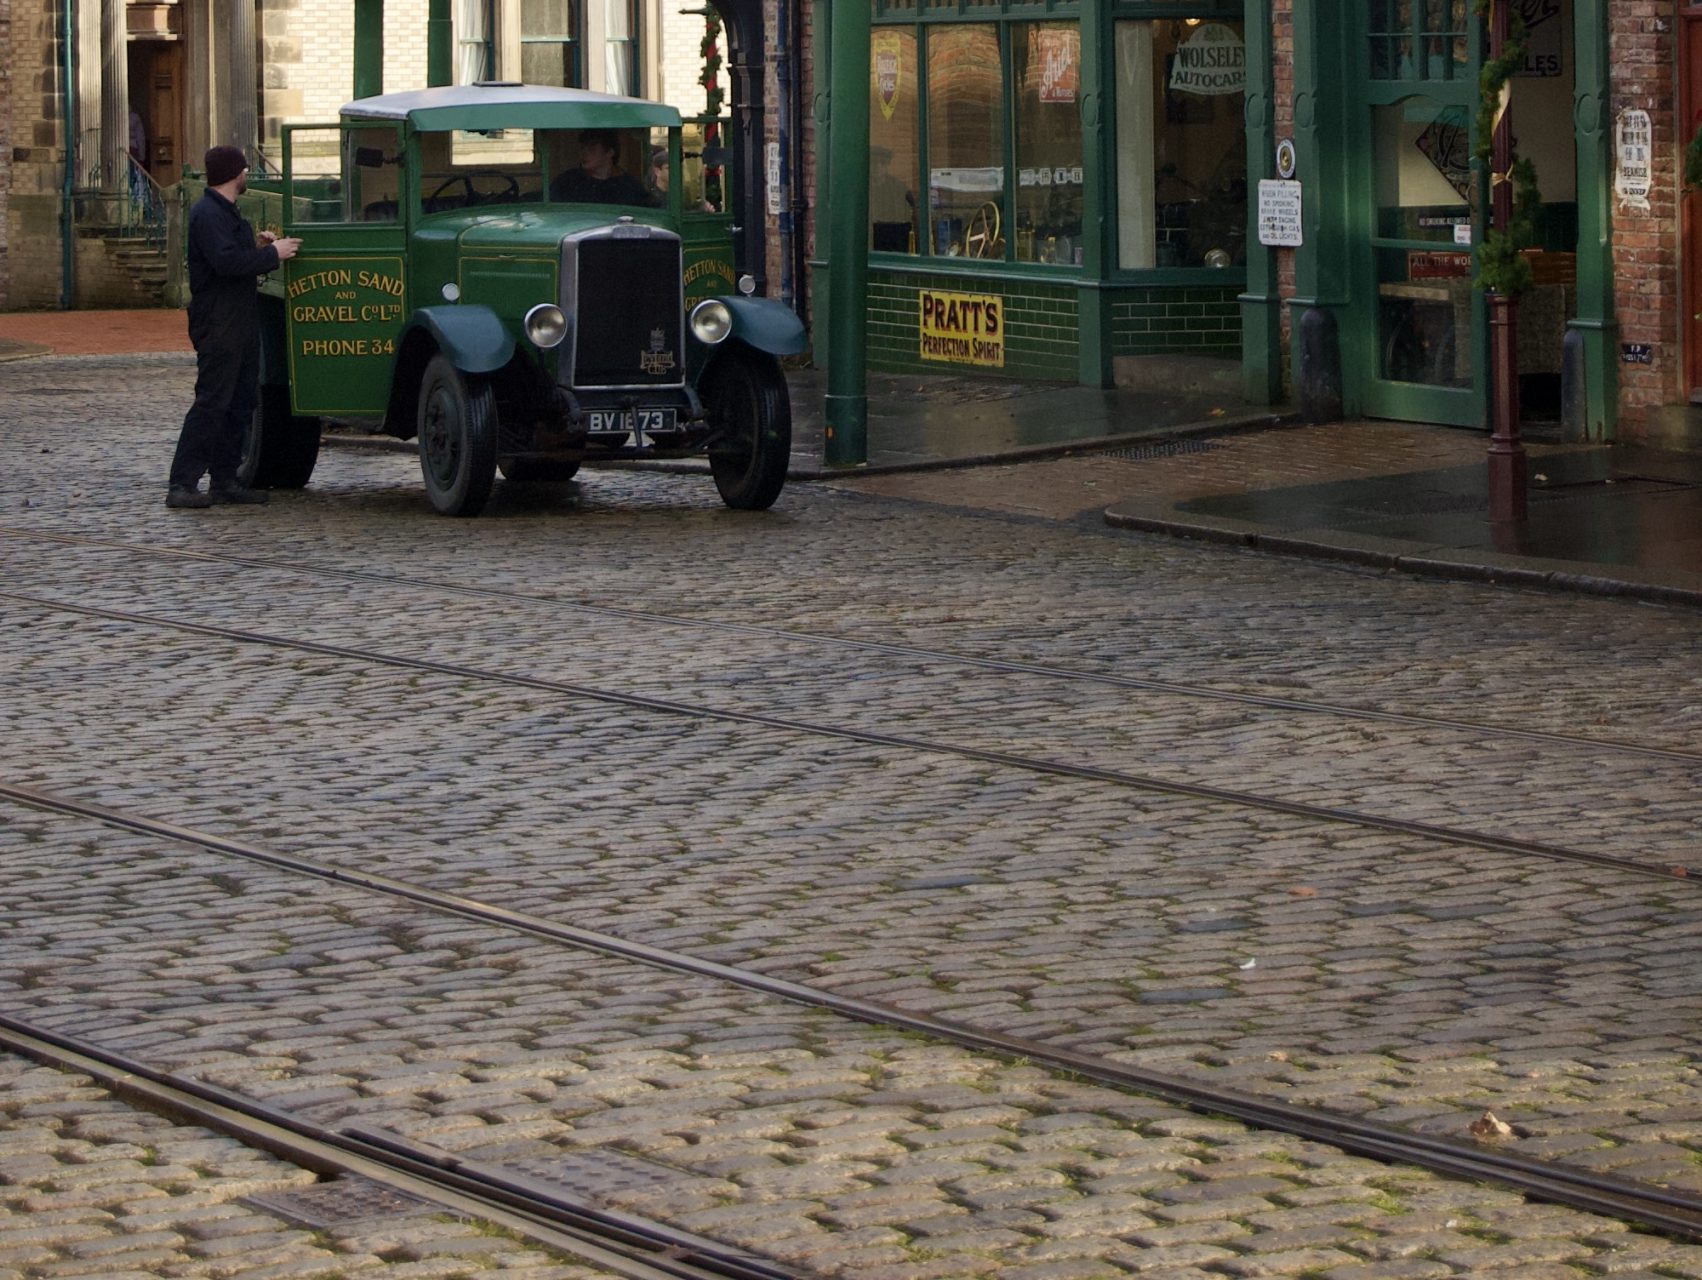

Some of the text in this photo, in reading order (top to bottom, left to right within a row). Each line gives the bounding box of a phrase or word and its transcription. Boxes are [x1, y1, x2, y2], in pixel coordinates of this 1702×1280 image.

[1524, 55, 1558, 72] LES
[1272, 200, 1294, 208] SMOKING
[1413, 255, 1428, 266] ALL
[1434, 256, 1449, 266] THE
[684, 258, 716, 287] HETTON
[288, 269, 405, 299] HETTON SAND
[335, 291, 357, 300] AND
[293, 306, 358, 323] GRAVEL
[923, 293, 999, 336] PRATT'S
[303, 339, 395, 356] PHONE 34
[922, 332, 1000, 360] PERFECTION SPIRIT
[590, 412, 615, 431] BV
